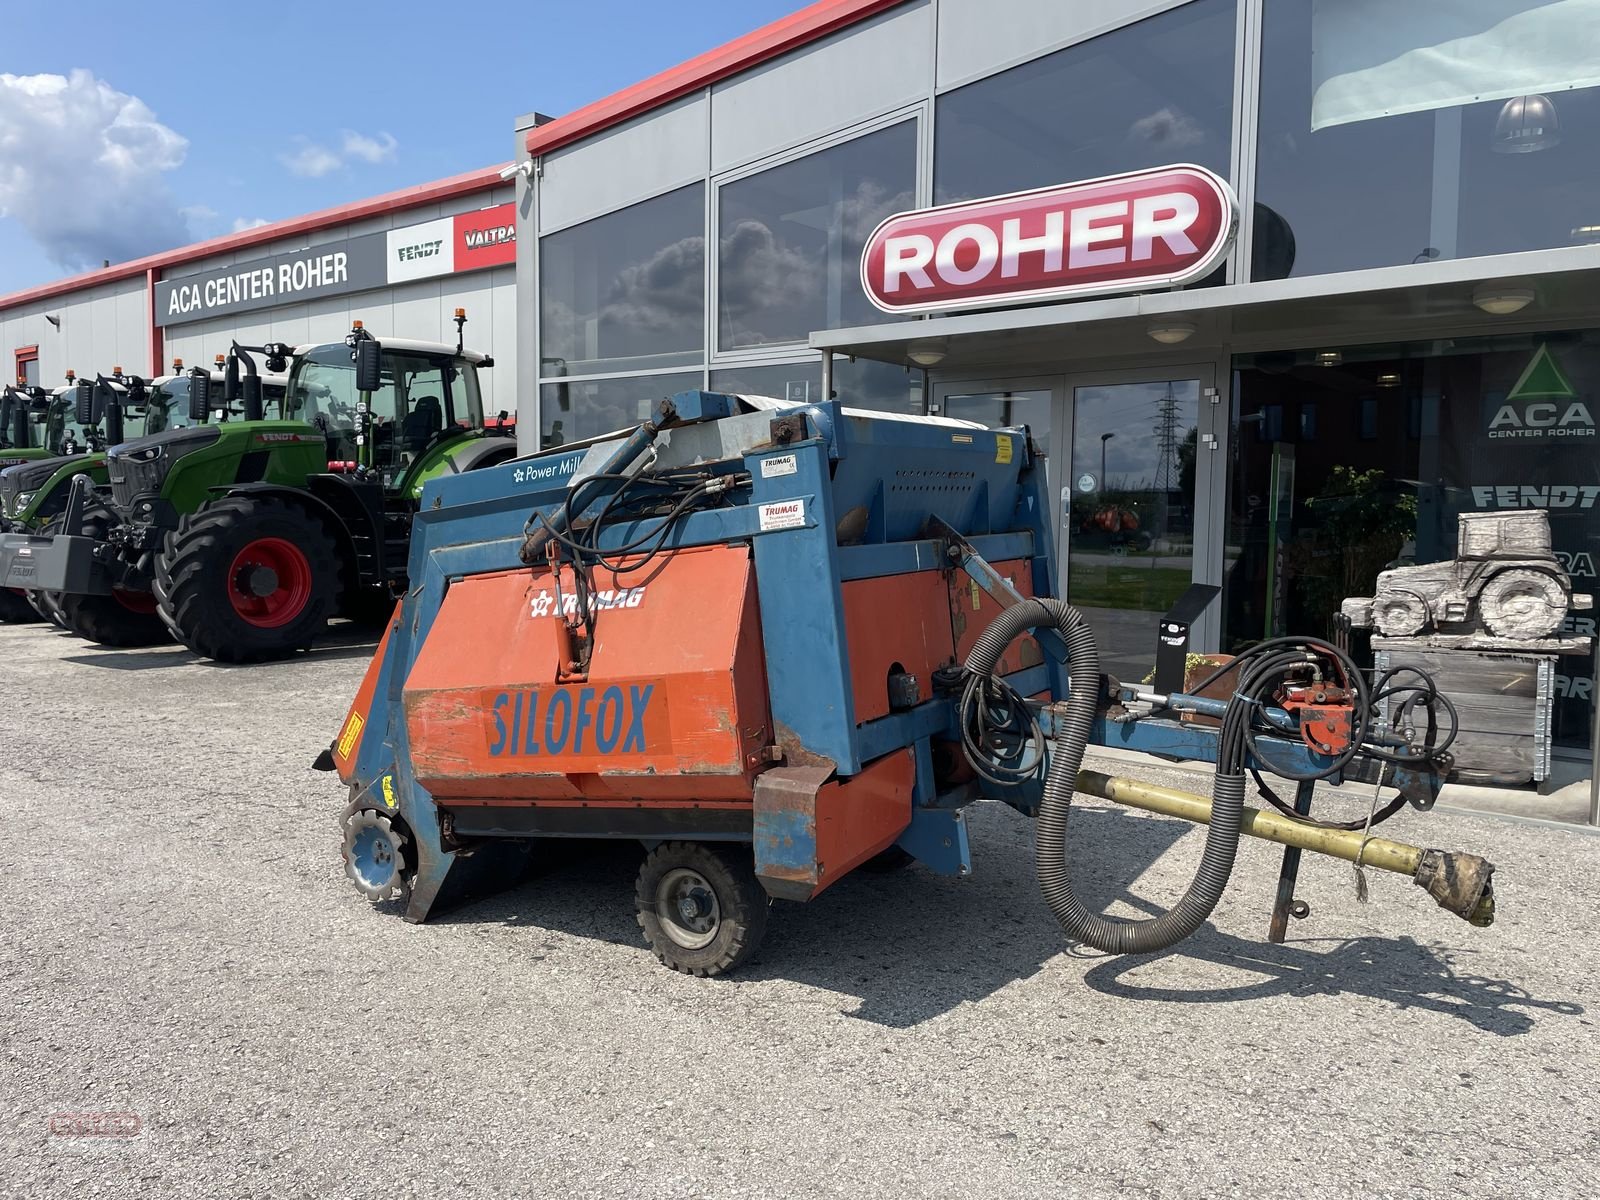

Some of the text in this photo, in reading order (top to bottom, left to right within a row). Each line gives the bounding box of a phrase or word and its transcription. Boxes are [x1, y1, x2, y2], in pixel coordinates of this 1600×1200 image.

[464, 224, 516, 250] VALTRA
[882, 192, 1200, 293] ROHER
[397, 239, 443, 262] FENDT
[168, 252, 348, 315] ACA CENTER ROHER
[1488, 402, 1596, 428] ACA
[262, 433, 294, 441] FENDT
[1488, 428, 1596, 439] CENTER ROHER
[526, 466, 557, 481] Power
[765, 457, 791, 467] TRUMAG
[1471, 485, 1600, 508] FENDT
[765, 504, 799, 516] TRUMAG
[1552, 551, 1597, 577] RA
[489, 684, 656, 756] SILOFOX
